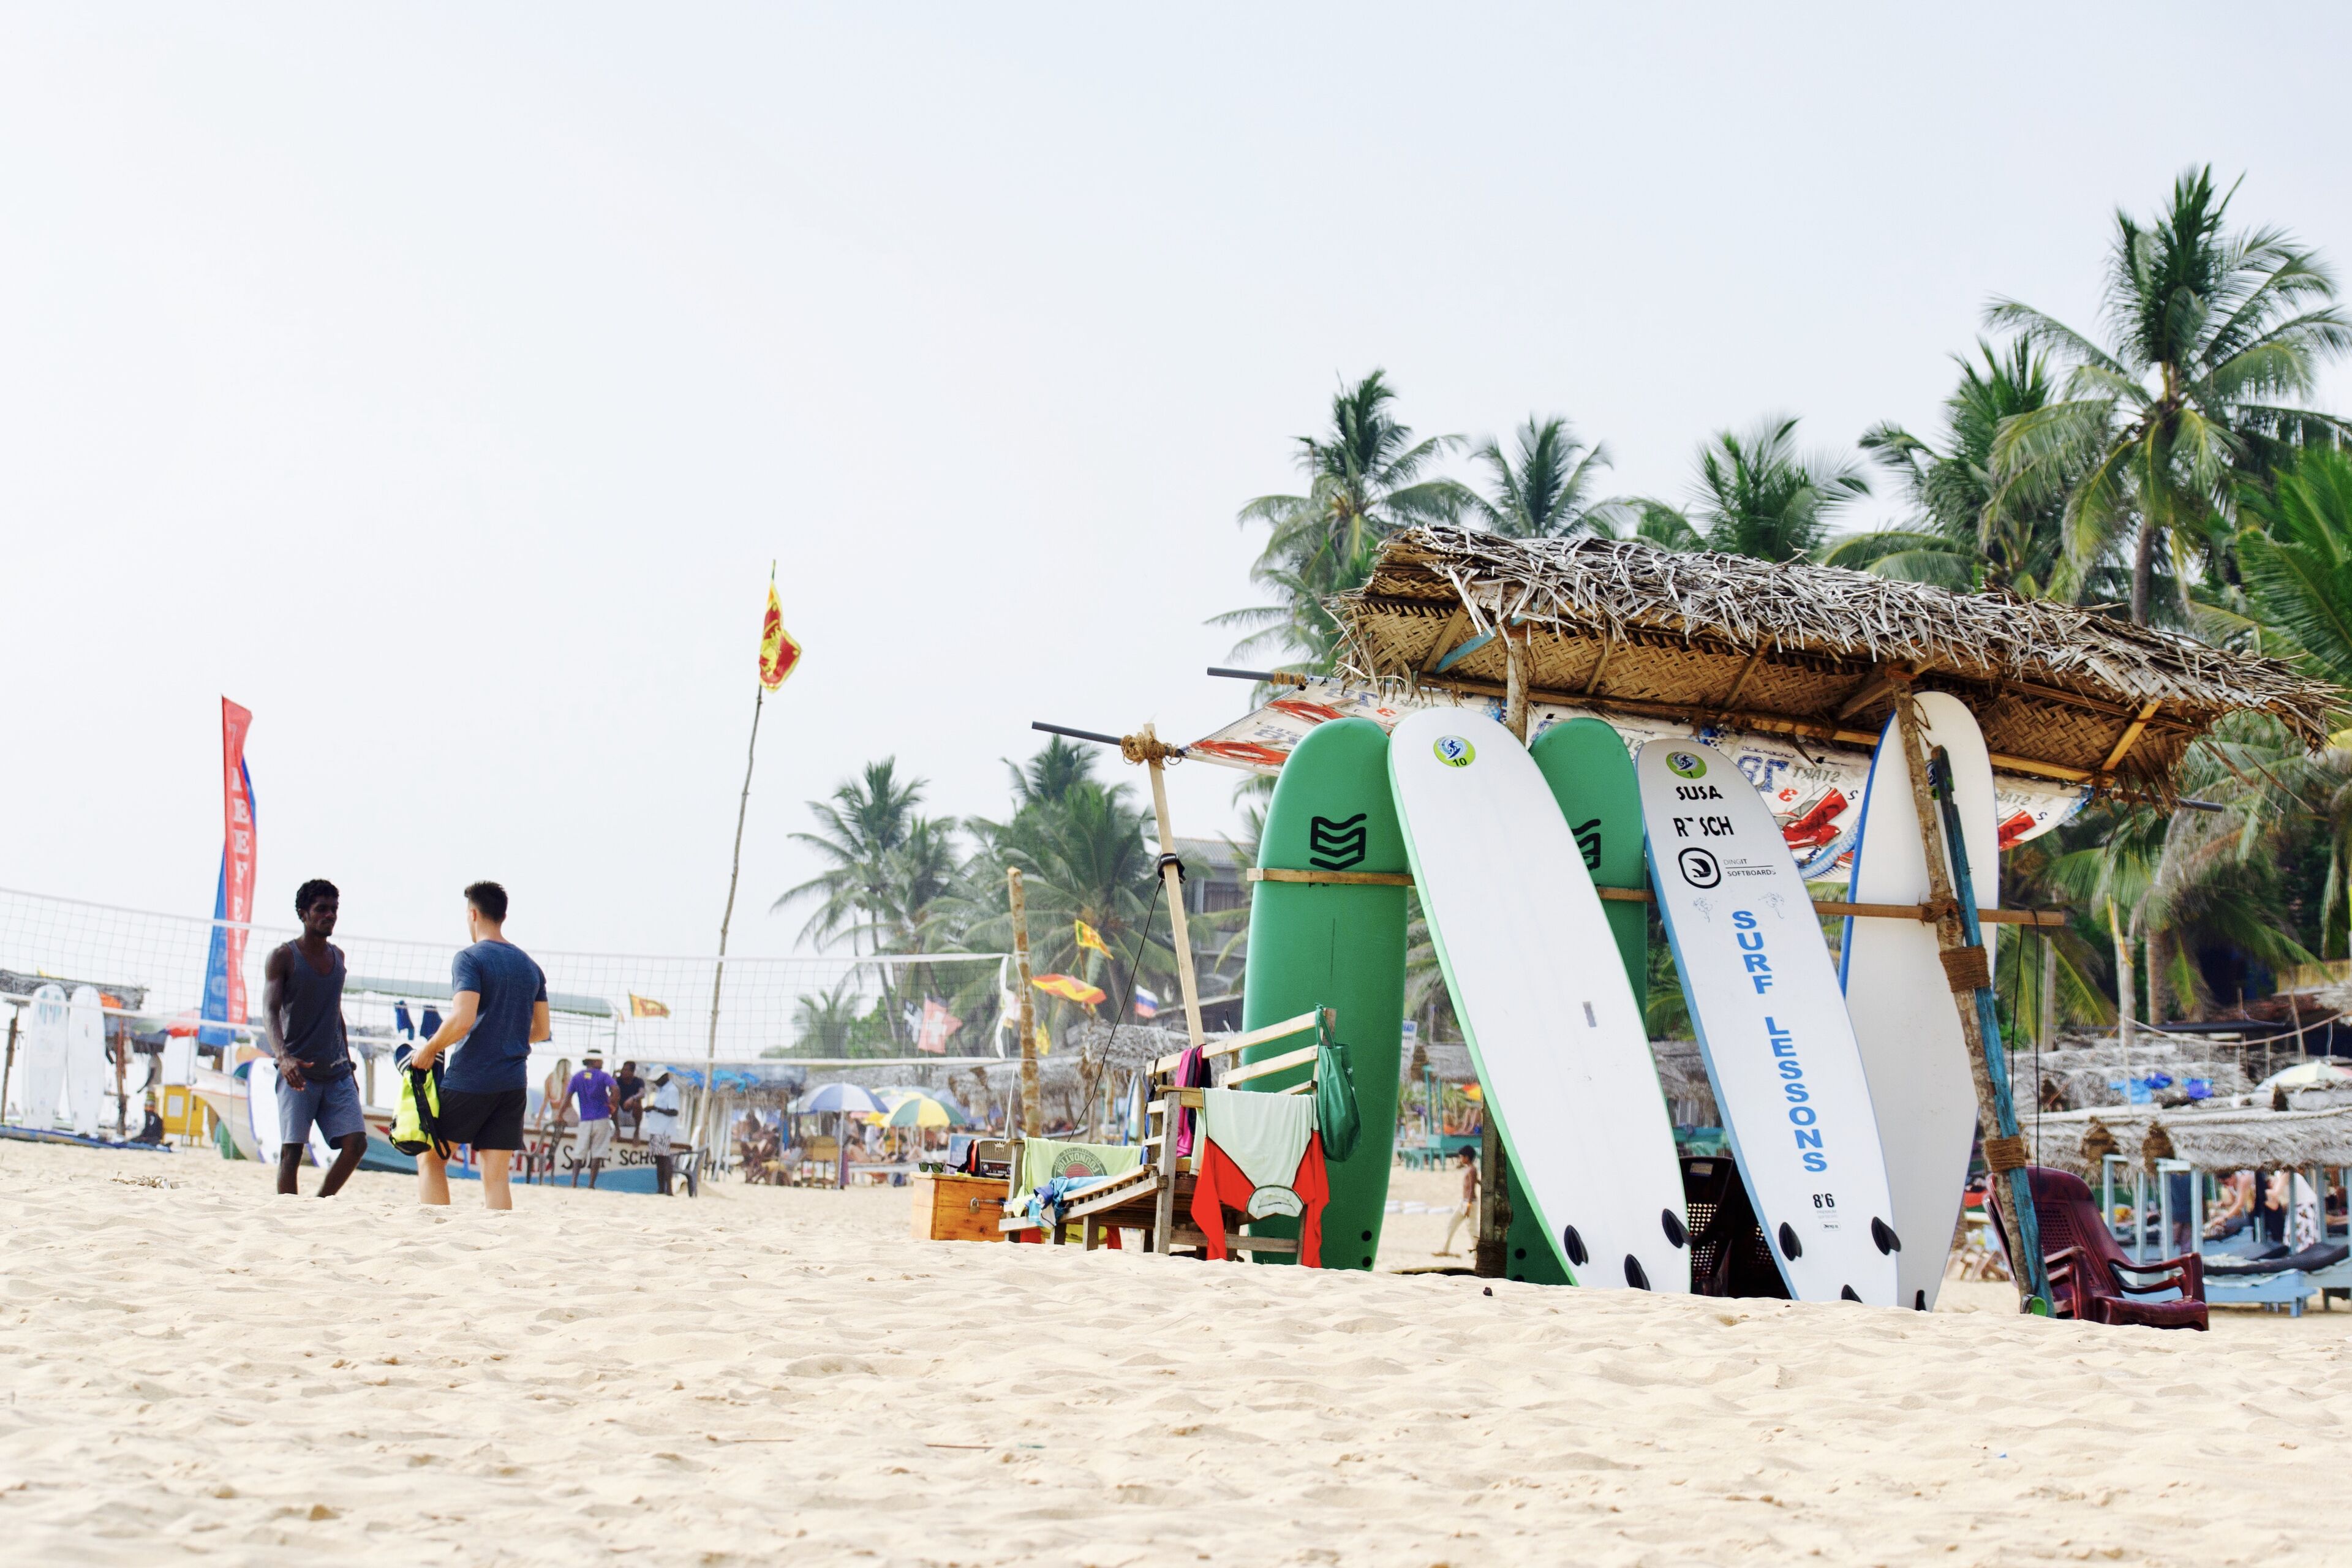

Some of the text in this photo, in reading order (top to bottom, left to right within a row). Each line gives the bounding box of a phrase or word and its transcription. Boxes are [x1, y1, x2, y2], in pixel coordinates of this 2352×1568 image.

[1452, 757, 1467, 766] 10
[1676, 785, 1724, 801] SUSA
[1732, 910, 1773, 994] SURF
[1765, 1017, 1828, 1172] LESSONS
[1057, 1153, 1100, 1174] FOUNDATION
